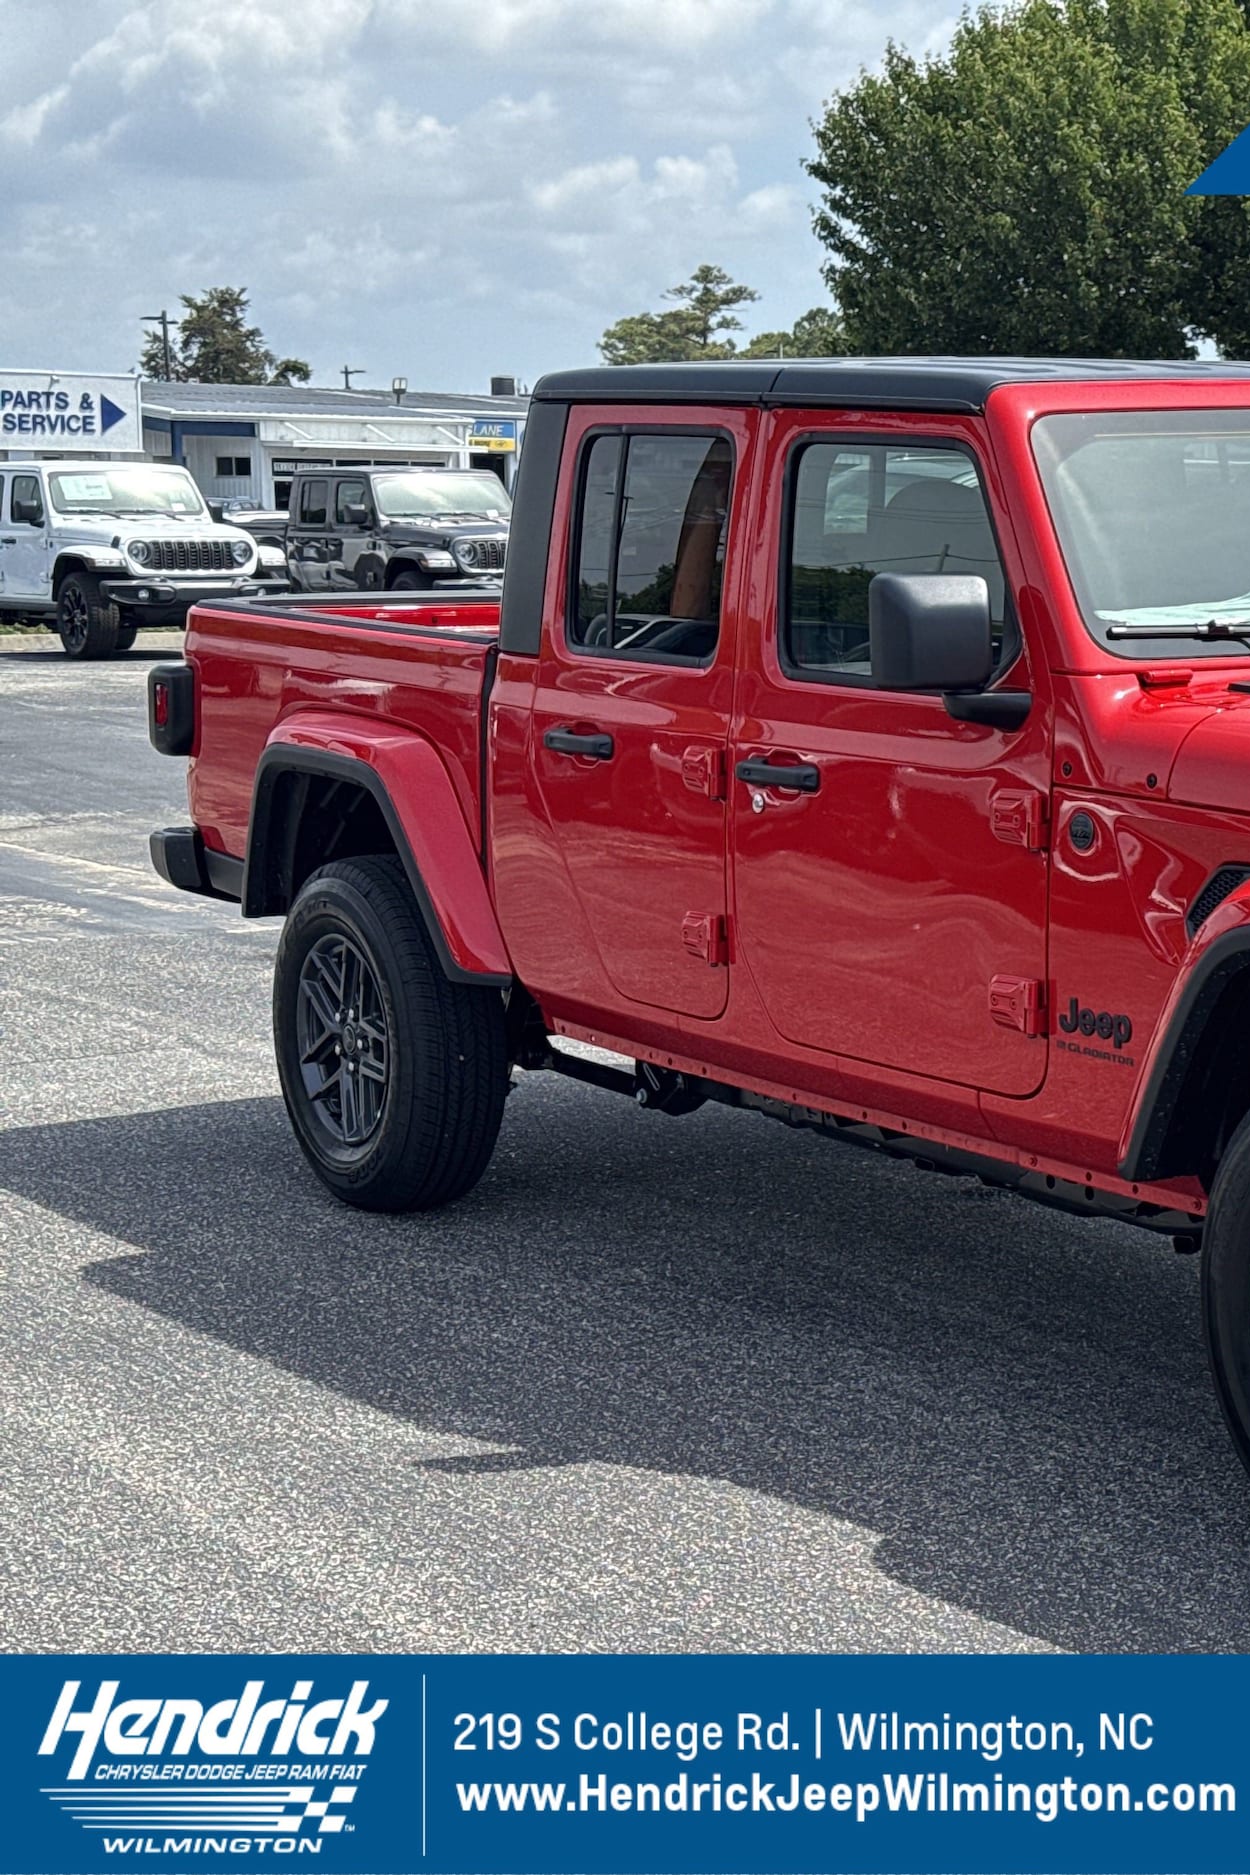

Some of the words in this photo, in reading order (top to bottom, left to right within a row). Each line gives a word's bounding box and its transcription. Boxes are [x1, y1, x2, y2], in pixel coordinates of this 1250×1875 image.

[1, 390, 69, 410] PARTS
[80, 392, 94, 410] &
[3, 413, 95, 433] SERVICE
[473, 424, 504, 437] LANE
[1059, 997, 1132, 1049] Jeep
[1068, 1042, 1134, 1067] GLADIATOR
